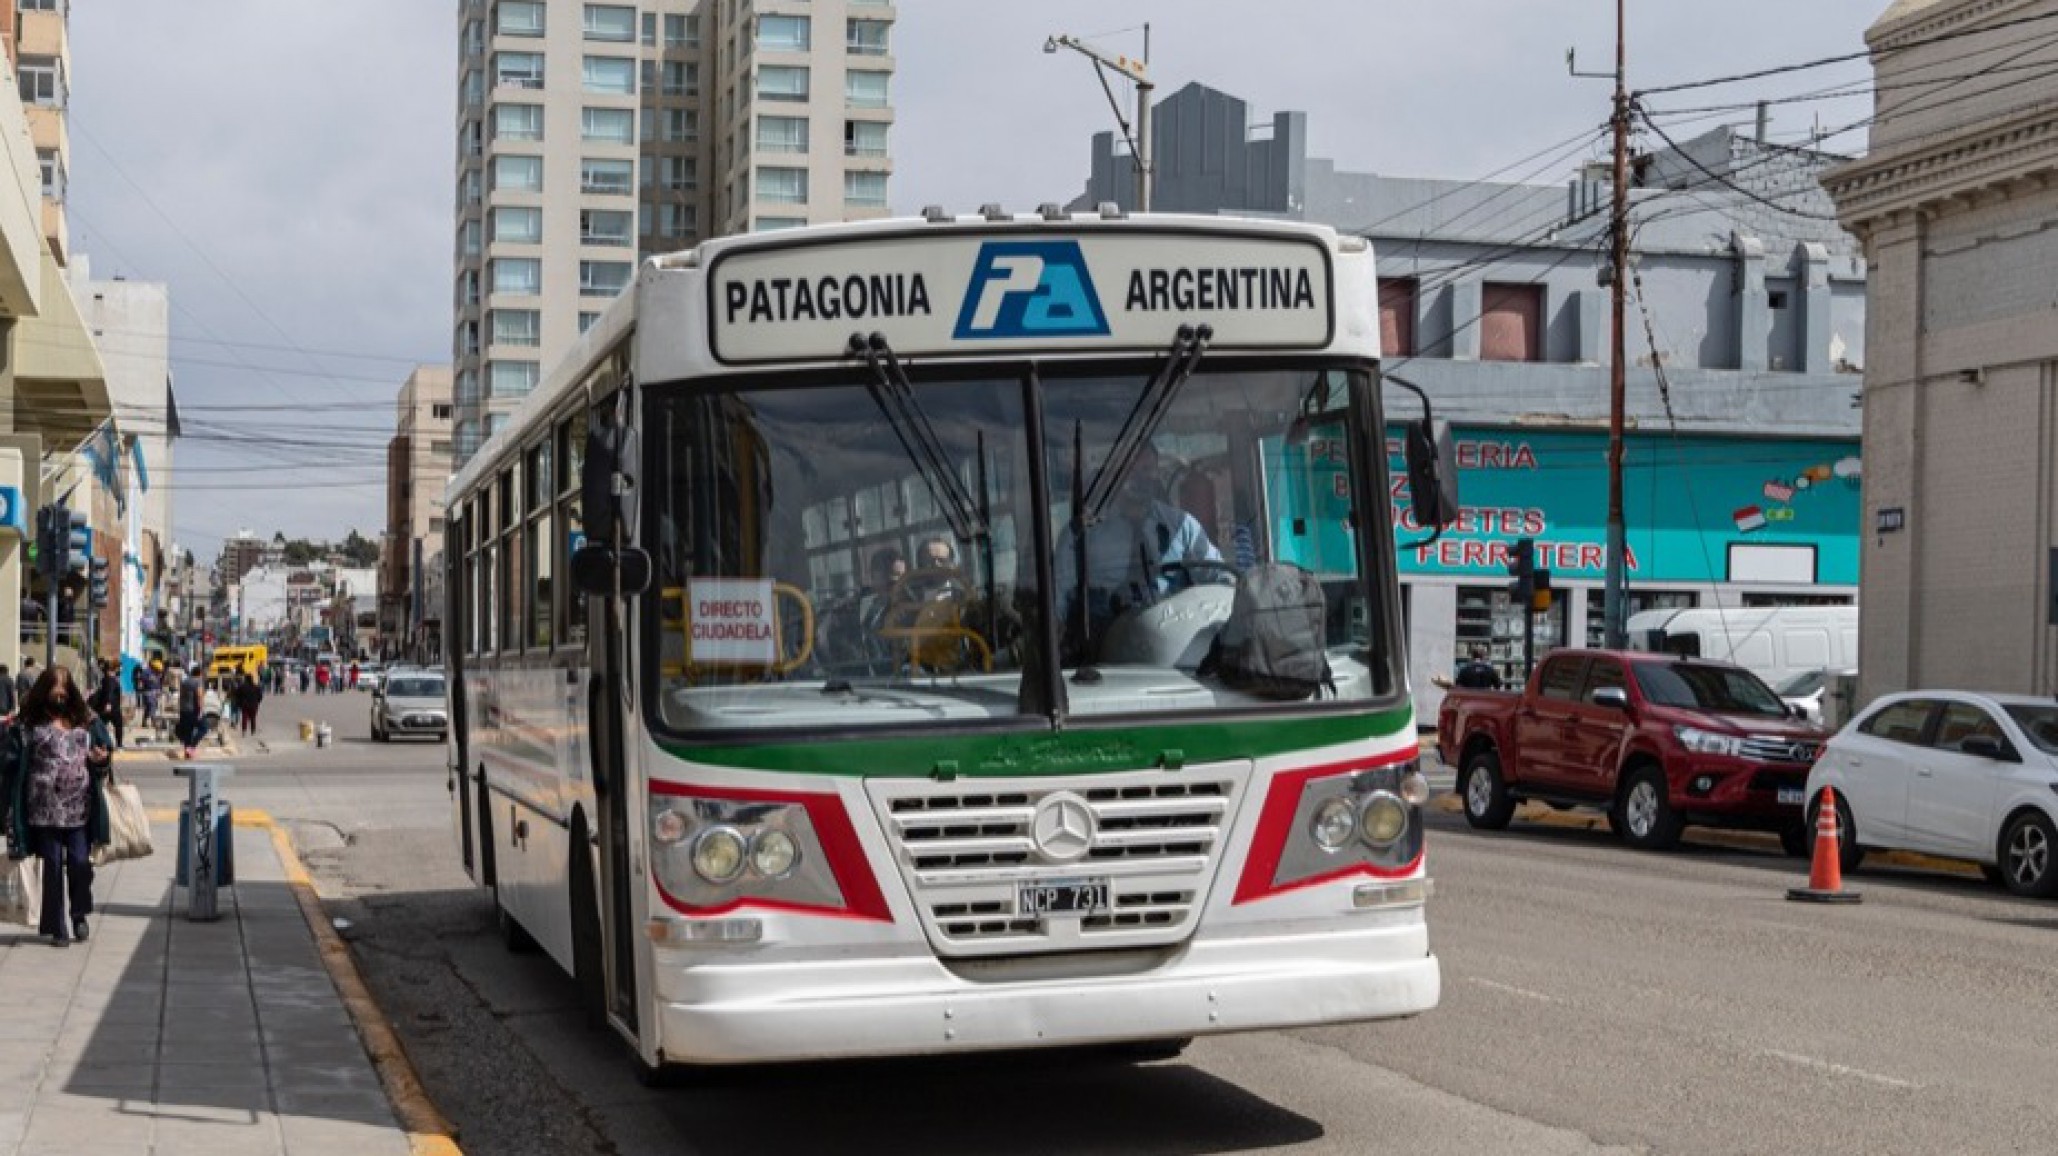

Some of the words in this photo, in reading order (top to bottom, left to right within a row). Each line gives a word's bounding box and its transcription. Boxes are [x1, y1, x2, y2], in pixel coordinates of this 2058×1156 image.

[726, 273, 931, 323] PATAGONIA
[1125, 267, 1315, 311] ARGENTINA
[699, 600, 763, 618] DIRECTO
[692, 622, 772, 641] CIUDADELA
[1021, 887, 1057, 911] NCP
[1070, 886, 1105, 909] 731
